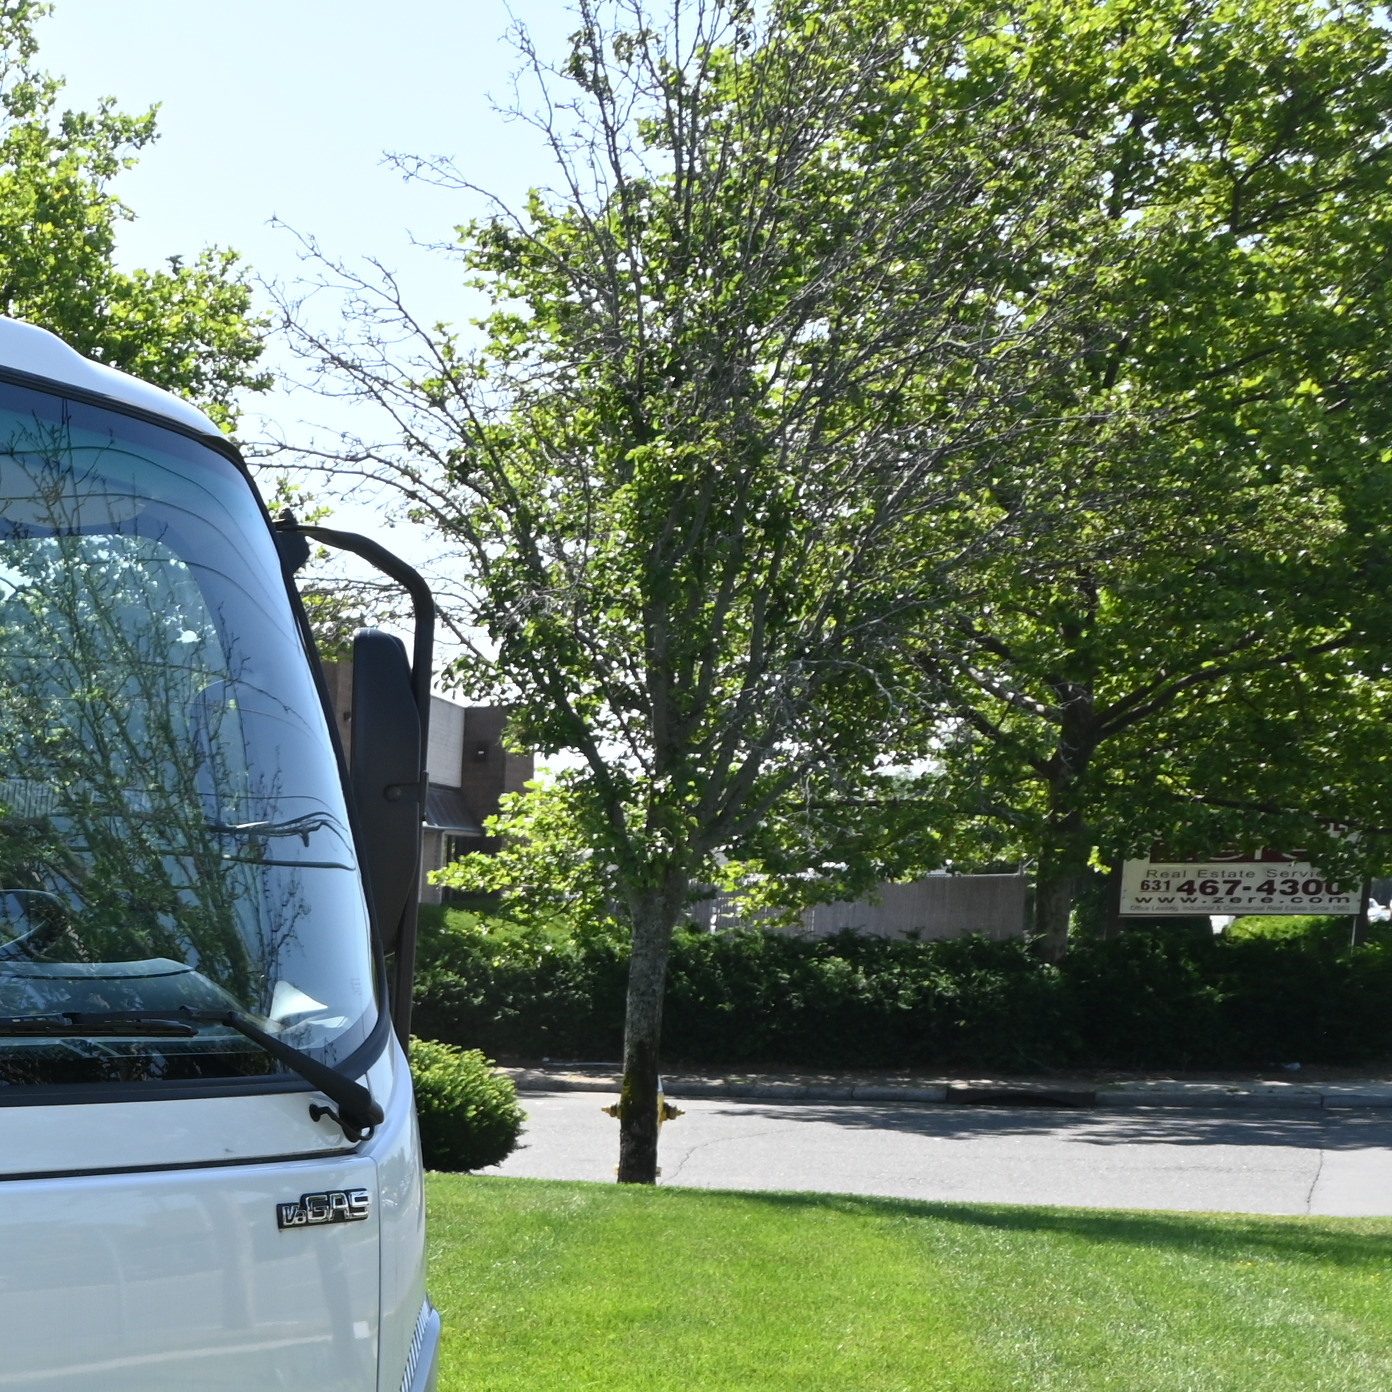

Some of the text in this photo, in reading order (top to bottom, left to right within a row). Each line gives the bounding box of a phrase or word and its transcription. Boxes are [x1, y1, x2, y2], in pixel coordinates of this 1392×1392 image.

[1147, 869, 1324, 878] Real Estate Servic
[1140, 879, 1345, 896] 631 467-4300
